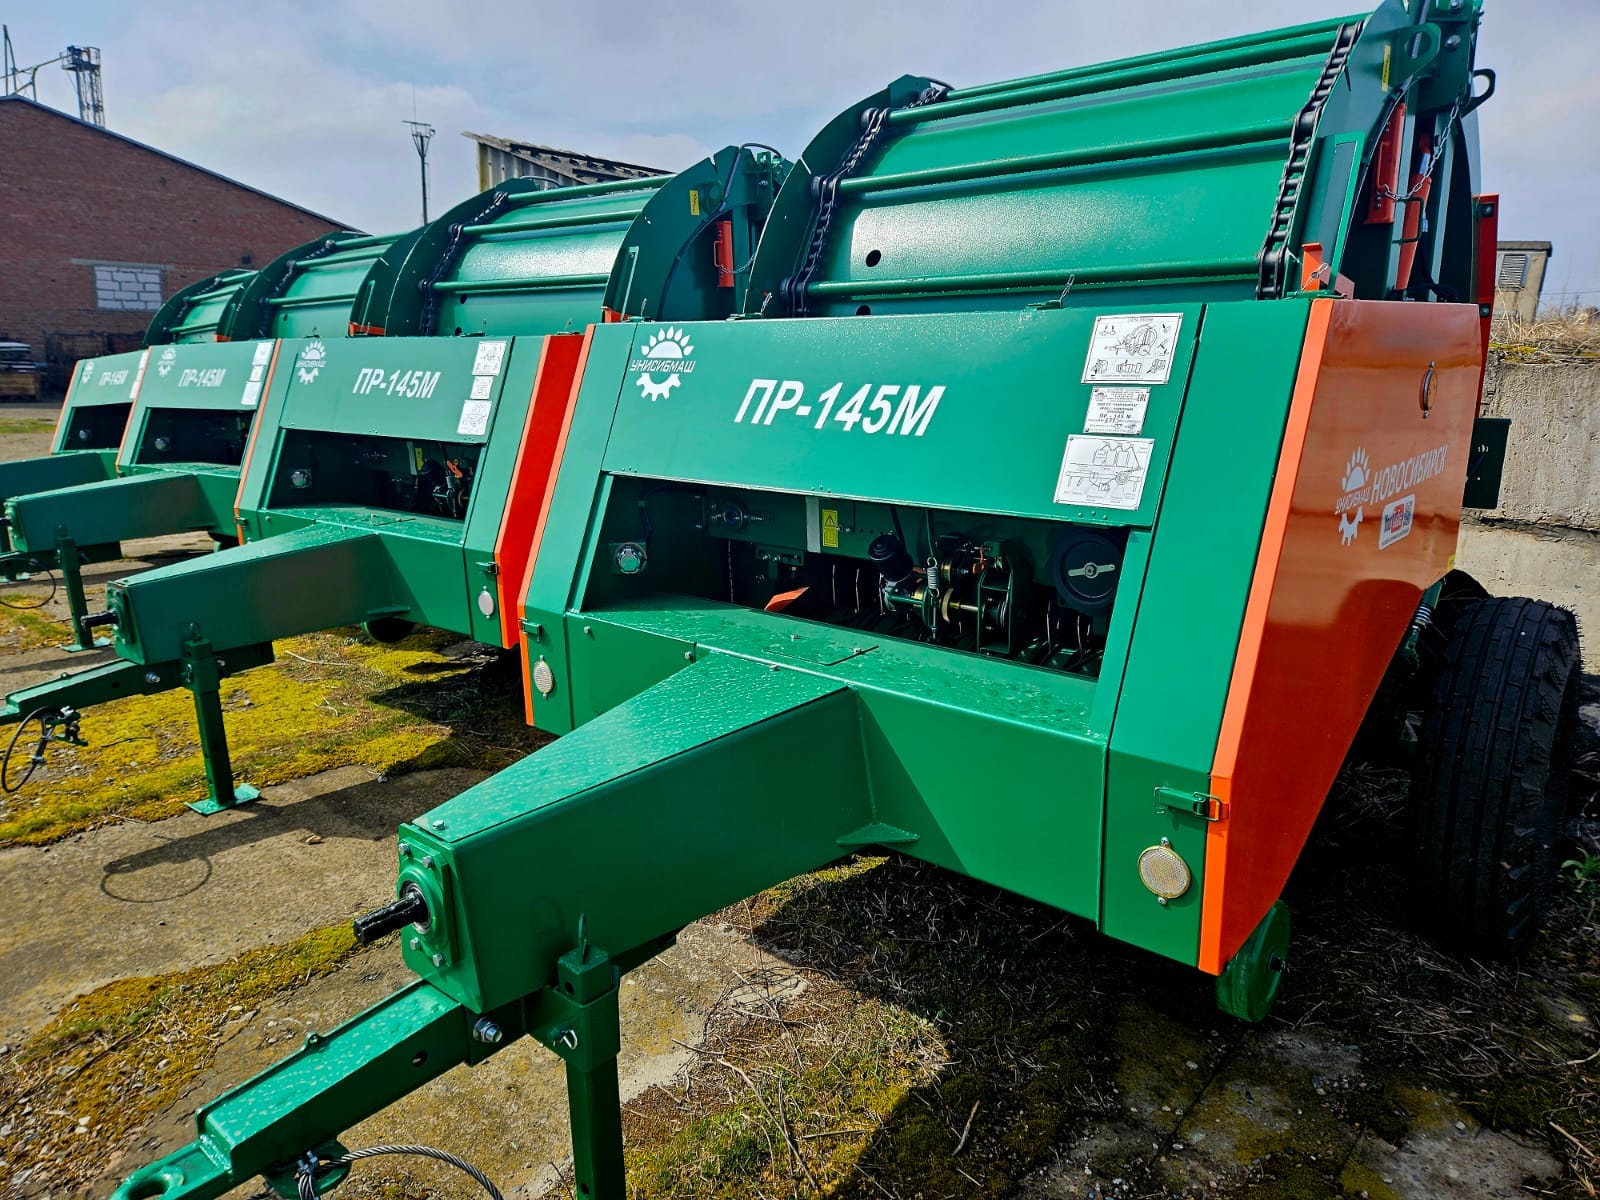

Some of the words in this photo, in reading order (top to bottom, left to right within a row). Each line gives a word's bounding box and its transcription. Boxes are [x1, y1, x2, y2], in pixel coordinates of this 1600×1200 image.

[178, 368, 227, 388] ПР-145М
[630, 359, 696, 373] УНИСИБМАШ
[352, 368, 441, 399] ПР-145М
[734, 378, 946, 437] ПР-145М
[1370, 445, 1448, 505] НОВОСИБИРСК
